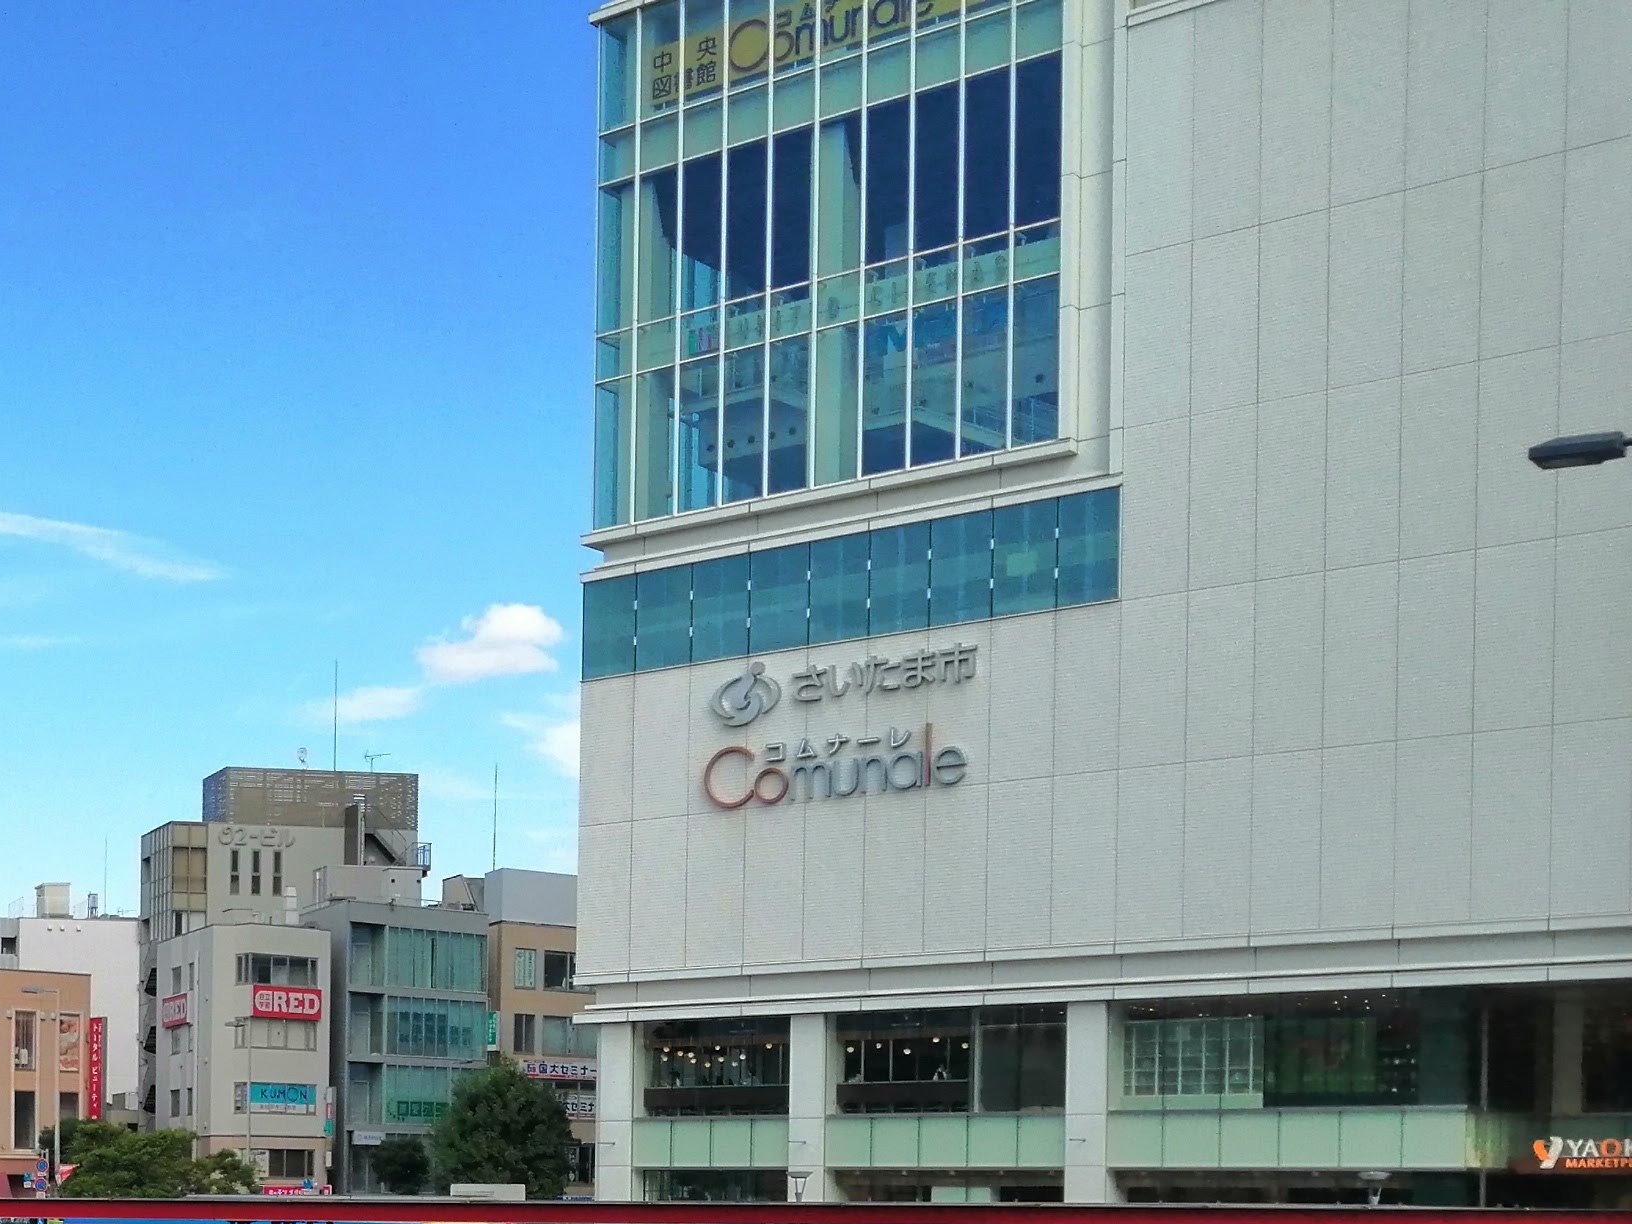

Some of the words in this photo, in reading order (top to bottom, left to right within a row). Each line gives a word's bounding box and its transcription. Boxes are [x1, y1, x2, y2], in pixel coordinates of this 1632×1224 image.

[653, 36, 718, 73] 中央
[652, 60, 717, 99] 図書館
[792, 642, 978, 702] さいたま市
[765, 726, 911, 763] コムナーレ
[704, 723, 967, 809] Comunale
[273, 991, 320, 1014] RED
[260, 1087, 307, 1102] KUMON
